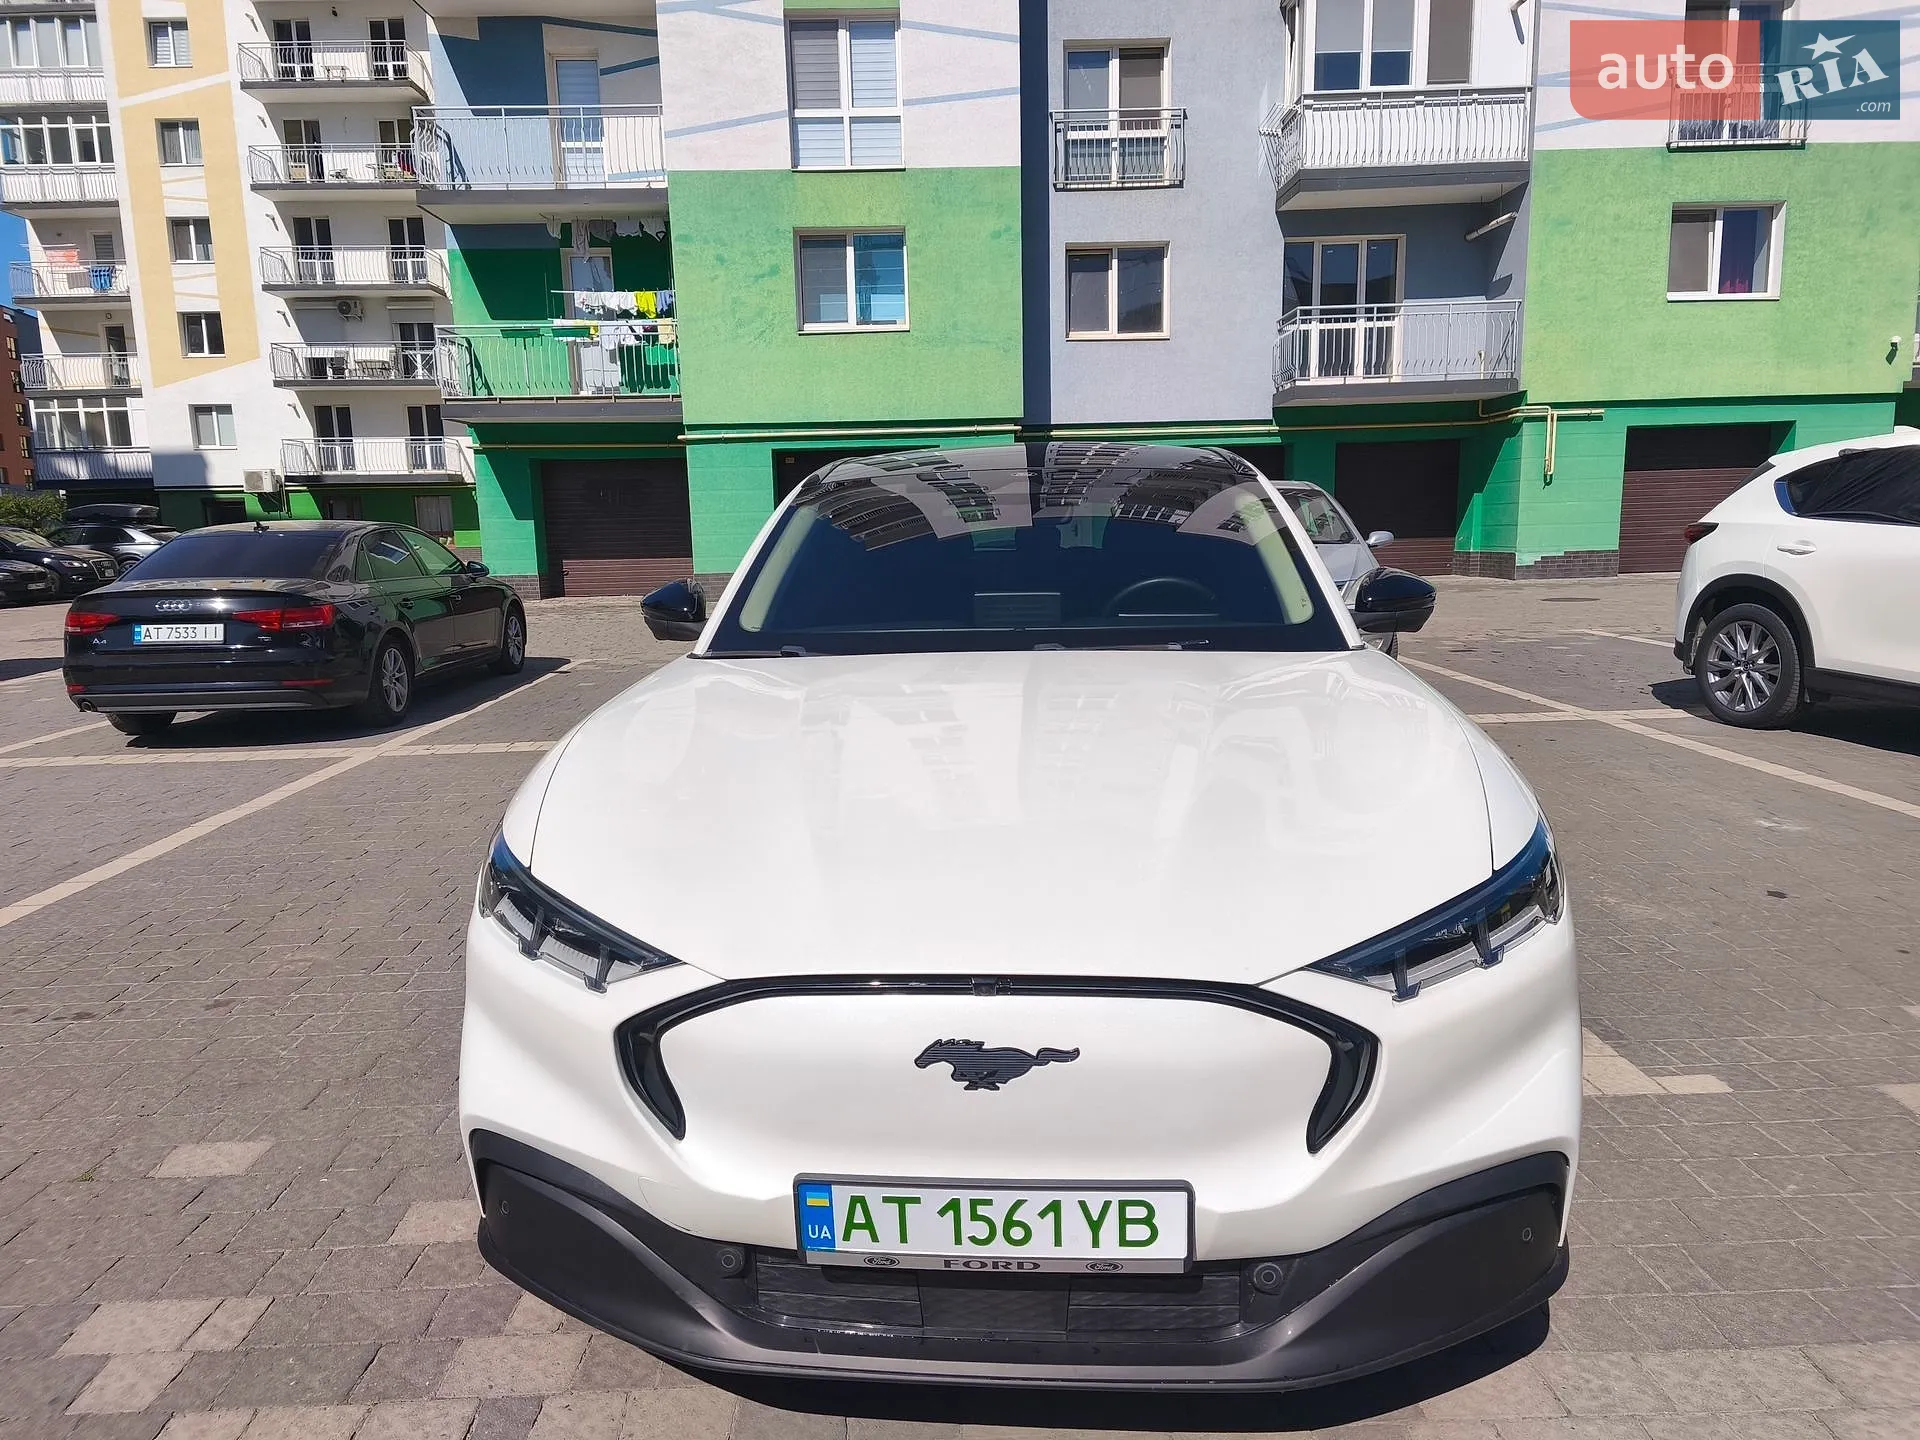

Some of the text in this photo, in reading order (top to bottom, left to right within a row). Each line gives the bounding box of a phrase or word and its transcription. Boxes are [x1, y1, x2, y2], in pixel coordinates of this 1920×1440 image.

[143, 627, 163, 640] AT
[166, 626, 197, 640] 7533
[842, 1195, 1159, 1249] AT 1561 YB
[808, 1224, 832, 1240] UA
[943, 1258, 1041, 1271] FORD
